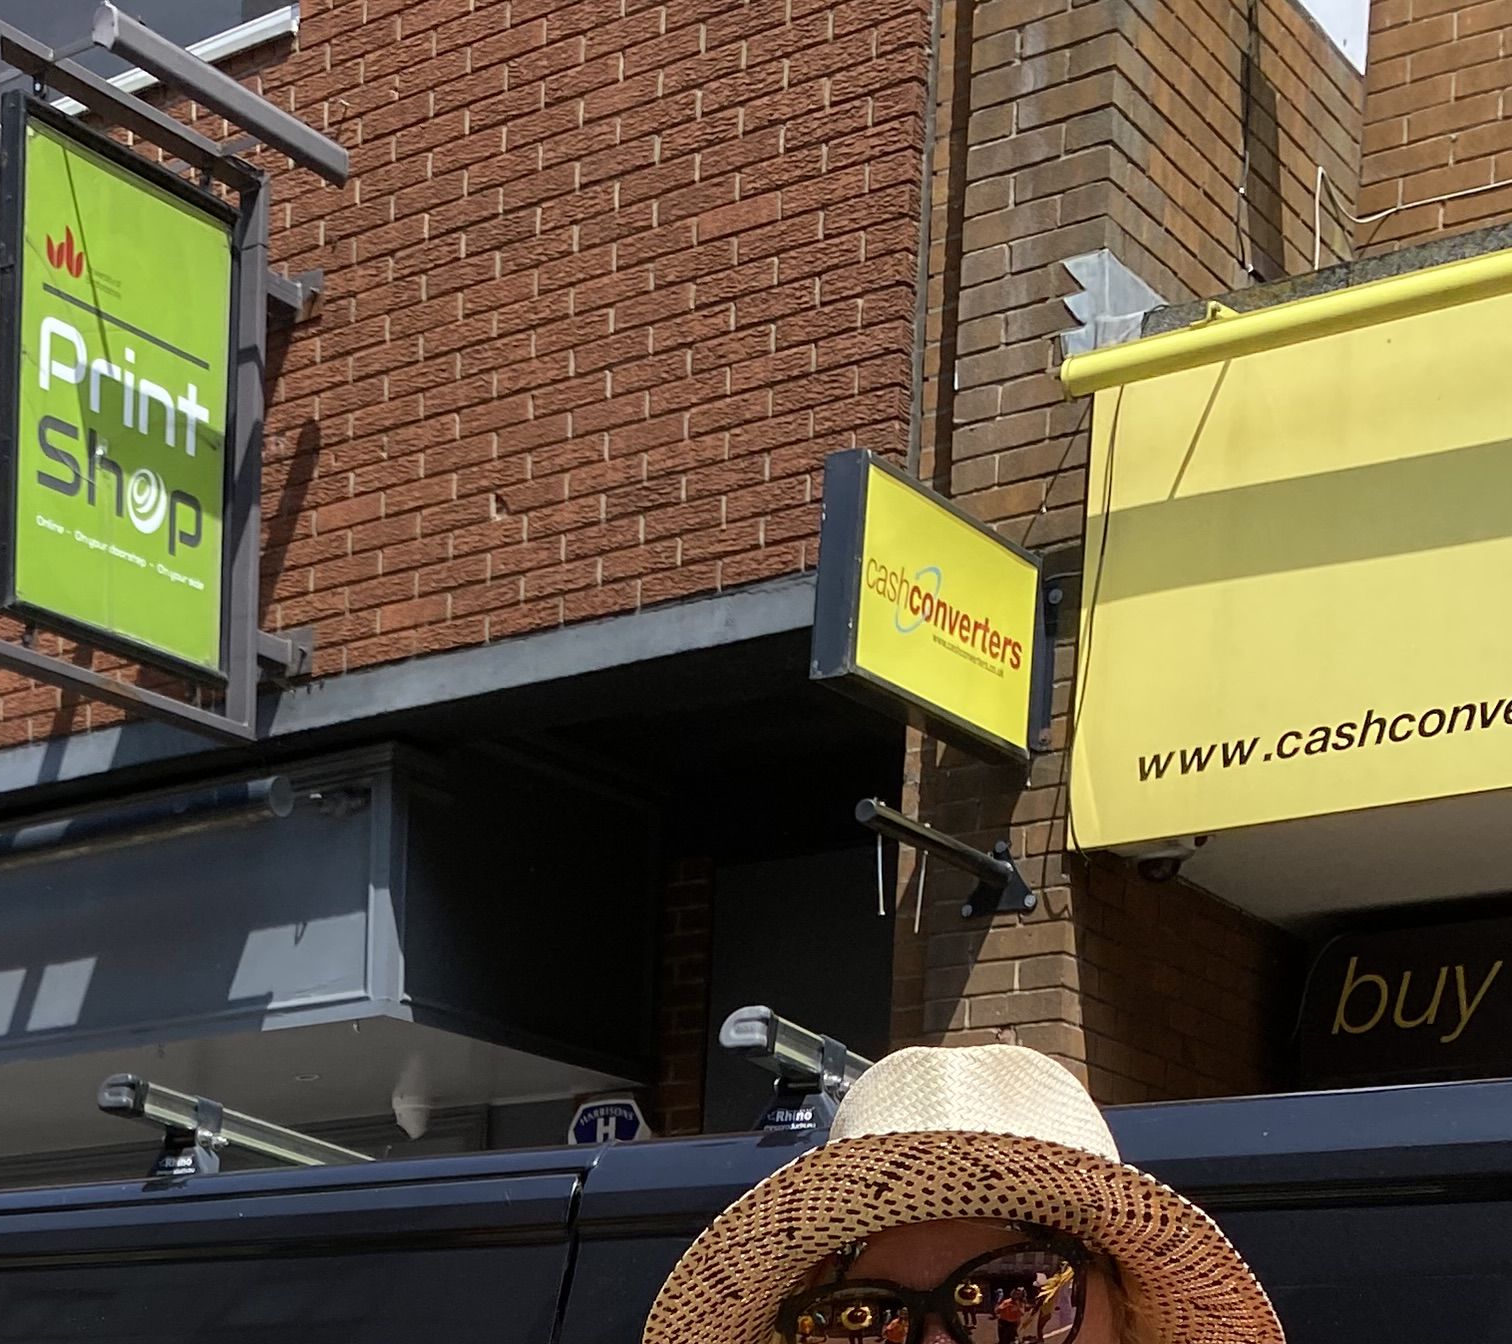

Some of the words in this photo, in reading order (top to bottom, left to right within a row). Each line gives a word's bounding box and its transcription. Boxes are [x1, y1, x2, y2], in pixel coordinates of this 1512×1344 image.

[39, 316, 209, 457] Print
[37, 415, 202, 556] Shop
[1331, 956, 1503, 1043] buy
[580, 1106, 635, 1126] HARRISONS
